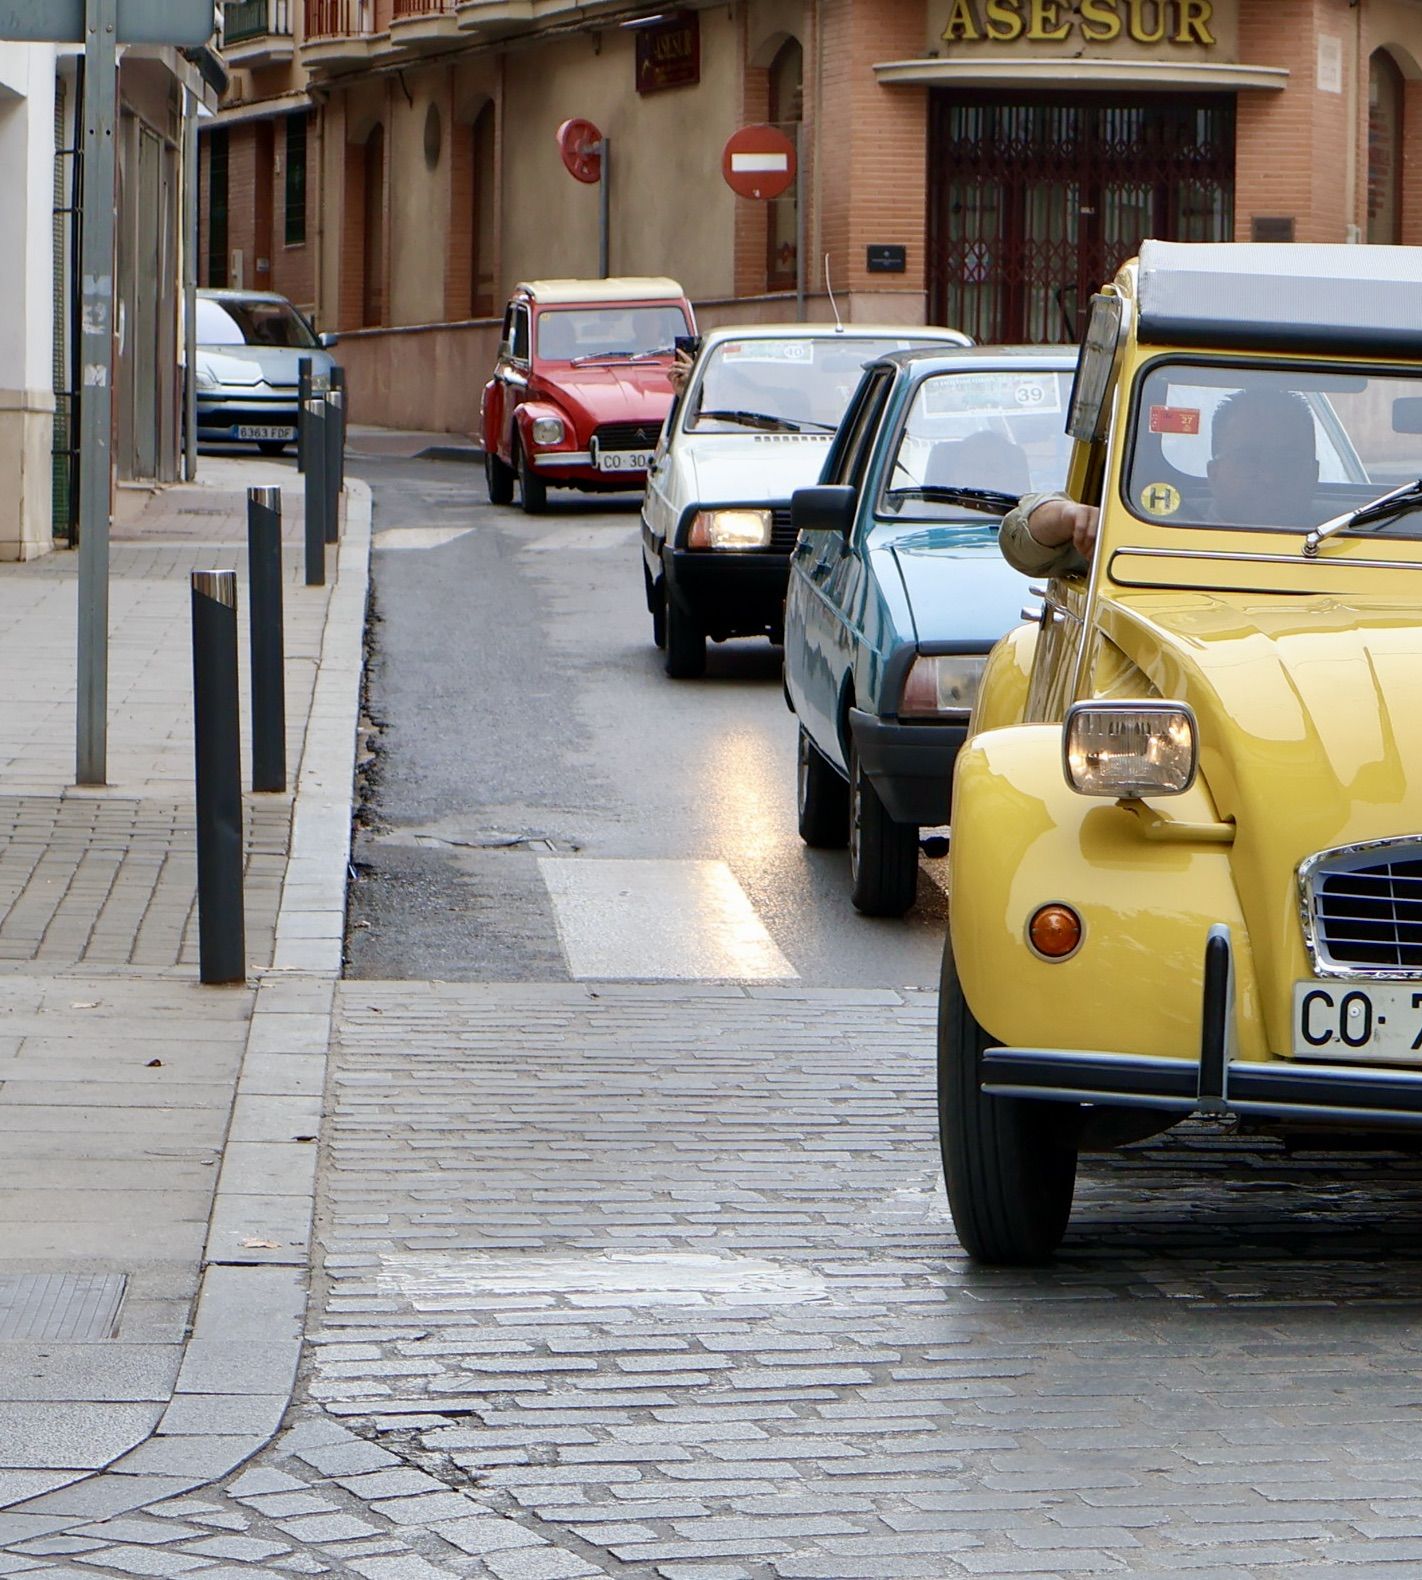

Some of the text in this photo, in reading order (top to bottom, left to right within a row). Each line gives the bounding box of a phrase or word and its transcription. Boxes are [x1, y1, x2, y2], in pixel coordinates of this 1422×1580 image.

[942, 0, 1216, 44] ASESUR
[1017, 387, 1043, 402] 39
[1150, 487, 1171, 510] H
